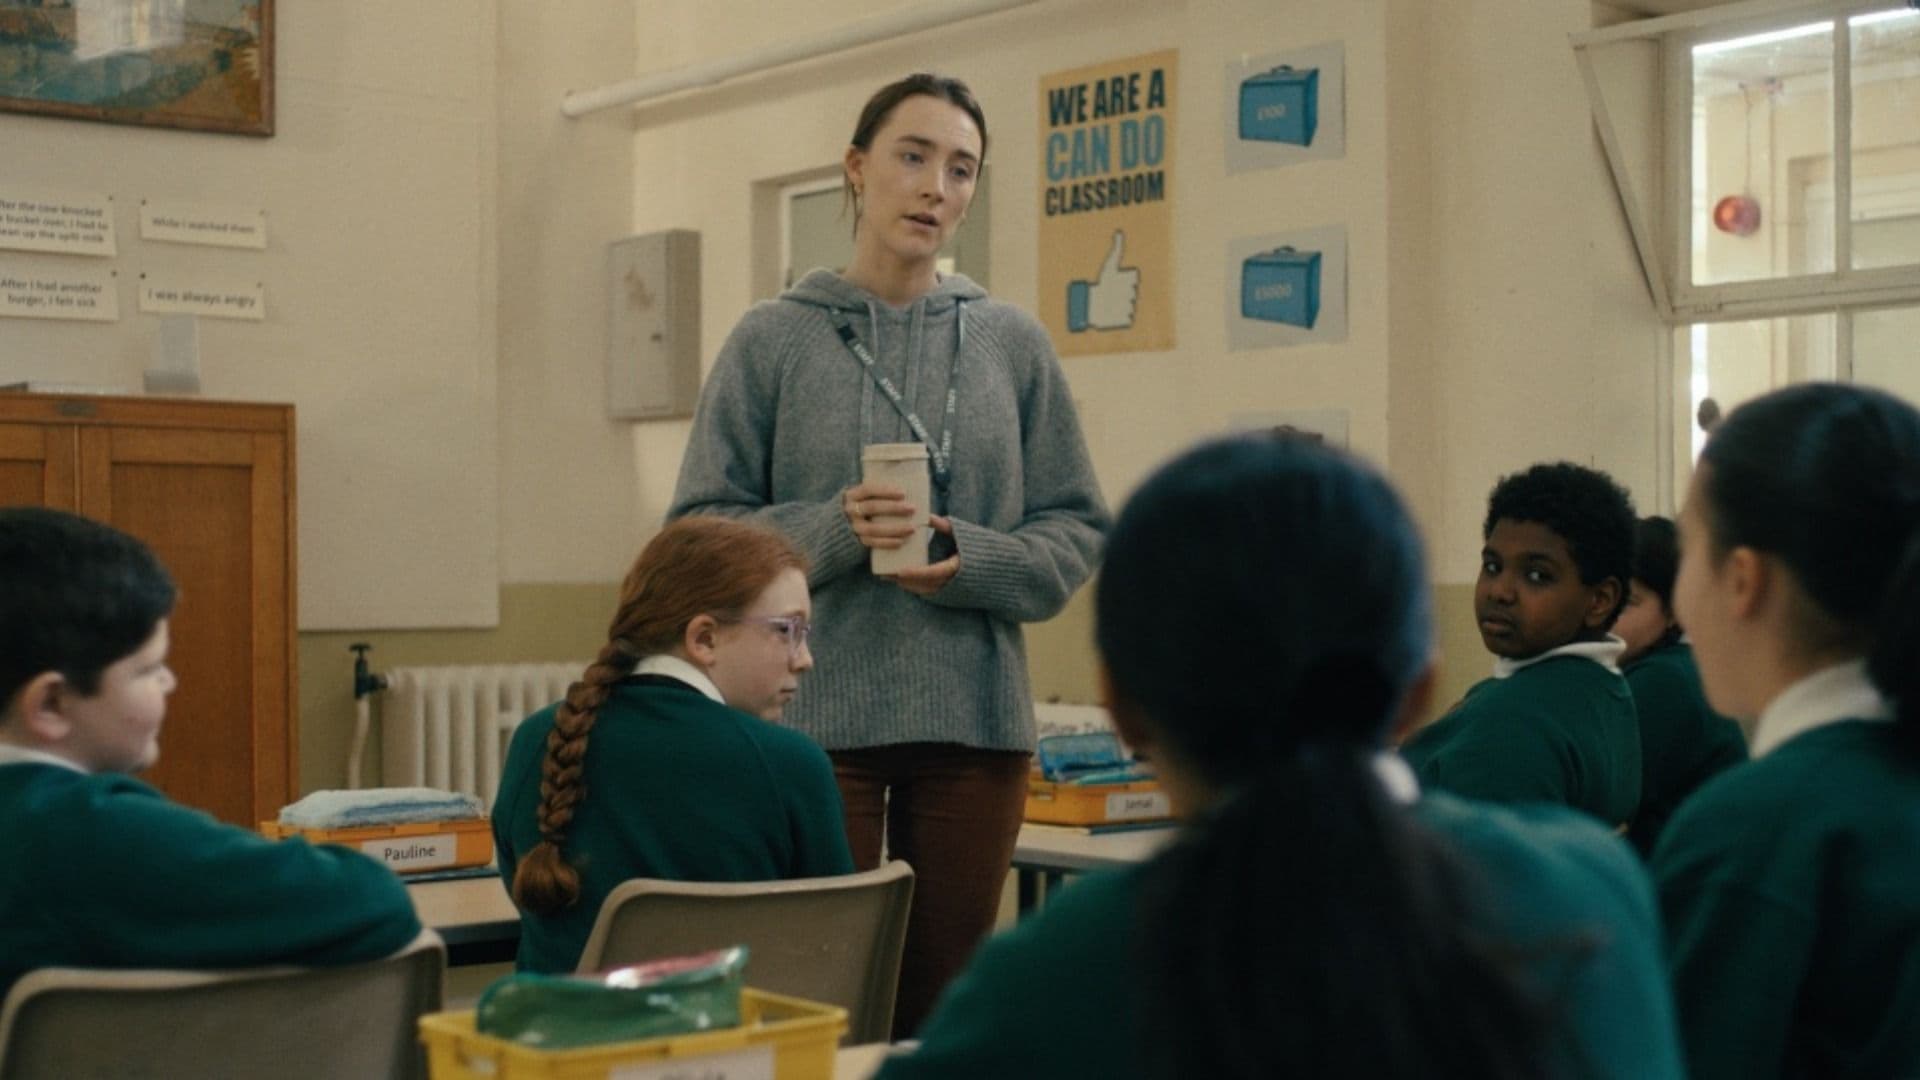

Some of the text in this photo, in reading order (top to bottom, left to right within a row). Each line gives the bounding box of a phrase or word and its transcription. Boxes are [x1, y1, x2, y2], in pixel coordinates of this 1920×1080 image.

[1048, 69, 1165, 127] WE ARE A
[1047, 114, 1164, 181] CAN DO
[1045, 170, 1164, 216] CLASSROOM
[19, 201, 36, 212] the
[61, 204, 103, 216] knocked
[6, 213, 40, 226] bucket
[76, 218, 95, 229] had
[97, 219, 108, 230] to
[152, 217, 179, 228] While
[188, 220, 228, 232] watched
[22, 230, 37, 241] up
[38, 230, 56, 240] the
[82, 232, 104, 243] milk
[0, 279, 27, 291] After
[36, 279, 57, 291] had
[60, 281, 102, 293] another
[7, 293, 47, 307] burger,
[55, 295, 73, 307] felt
[76, 296, 97, 308] sick
[155, 291, 178, 302] was
[182, 290, 221, 305] always
[224, 294, 256, 308] angry
[384, 845, 437, 861] Pauline
